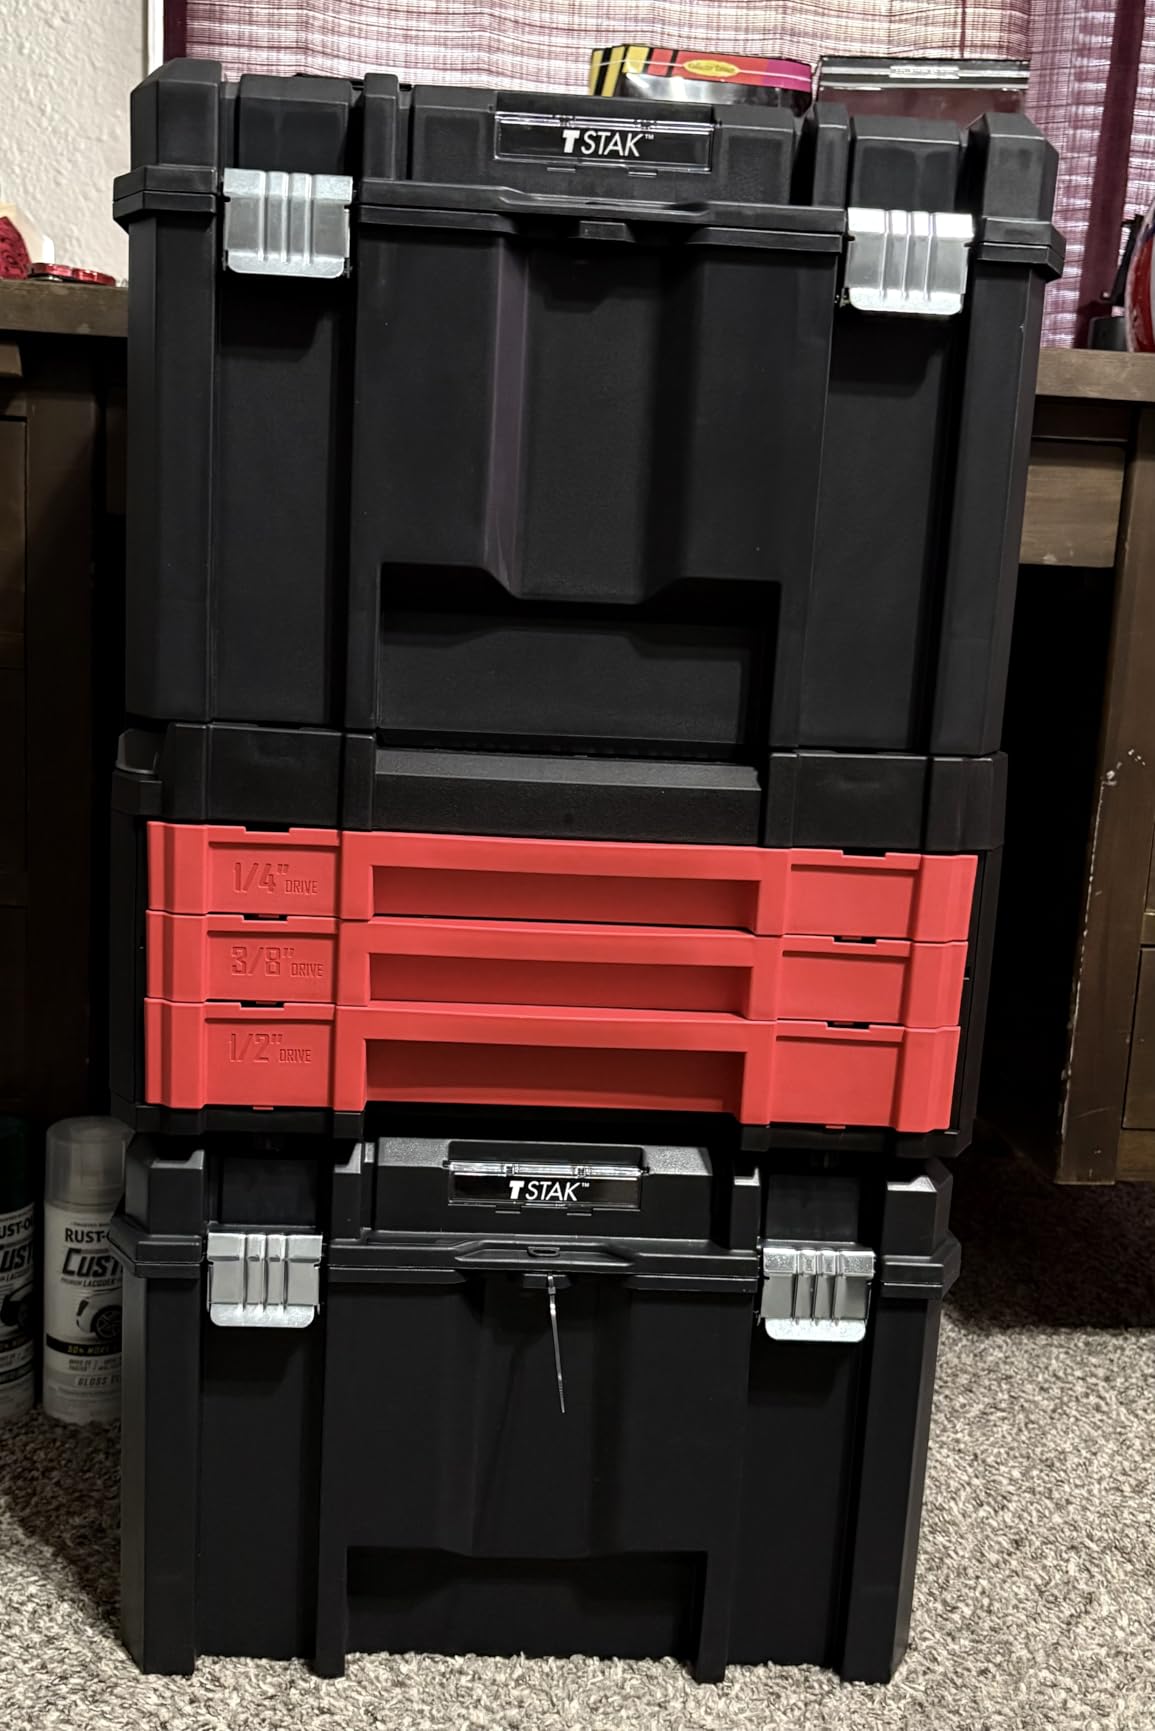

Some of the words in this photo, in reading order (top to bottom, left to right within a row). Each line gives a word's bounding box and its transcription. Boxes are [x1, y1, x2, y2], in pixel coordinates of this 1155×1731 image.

[233, 862, 289, 893] 1/4"
[285, 879, 318, 895] DRIVE
[231, 946, 295, 976] 3/8"
[290, 962, 323, 977] DRIVE
[229, 1033, 283, 1063] 1/2"
[279, 1048, 312, 1063] DRIVE
